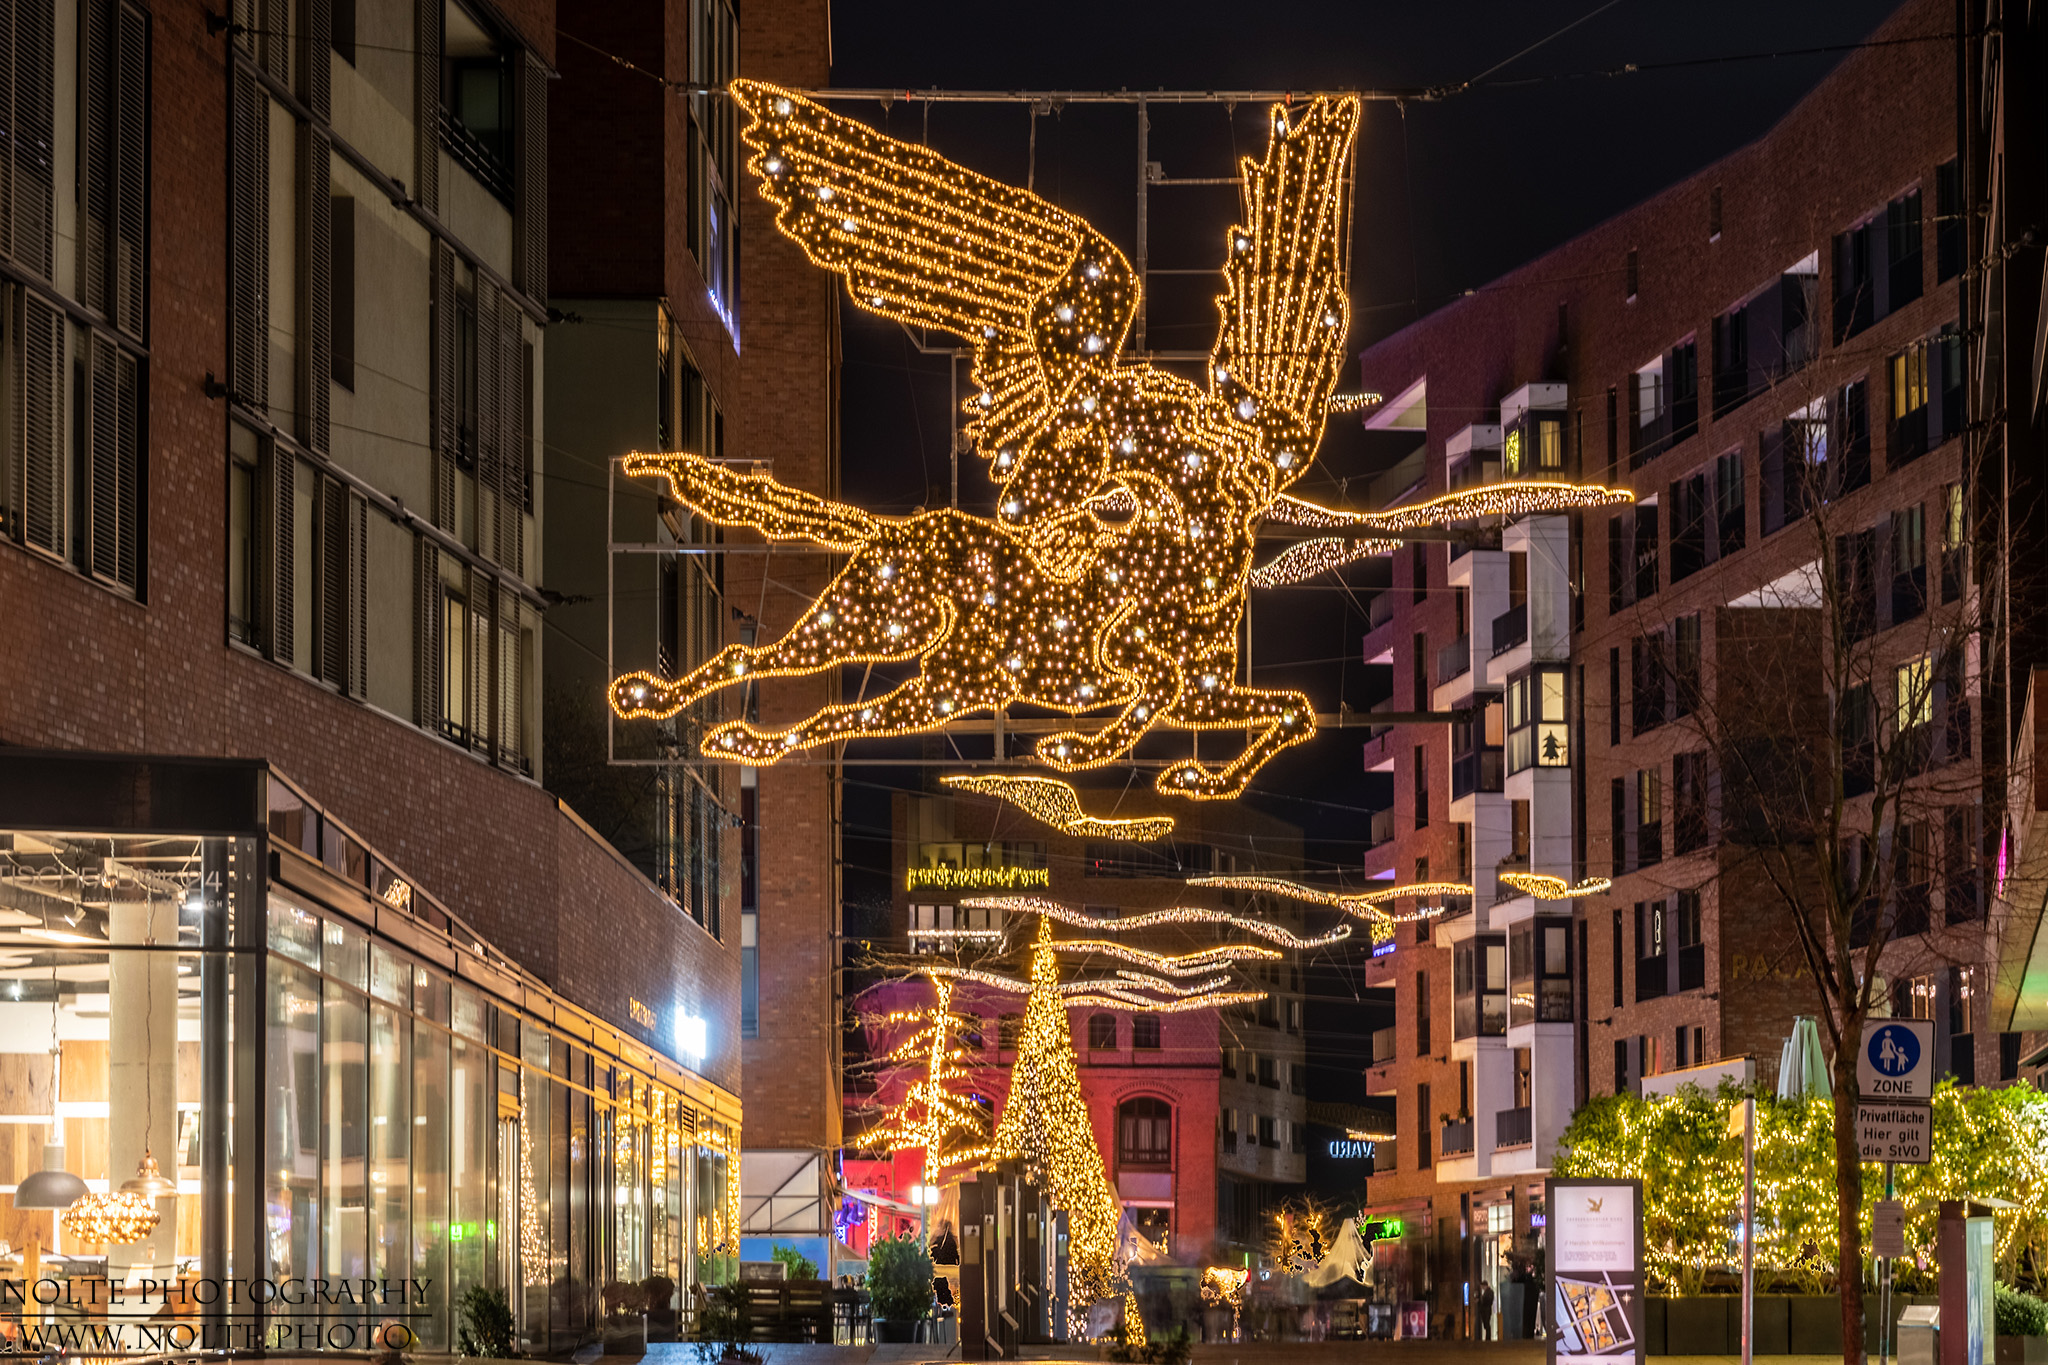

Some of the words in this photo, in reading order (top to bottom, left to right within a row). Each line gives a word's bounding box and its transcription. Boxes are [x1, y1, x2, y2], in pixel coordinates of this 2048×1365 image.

[1872, 1079, 1913, 1094] ZONE
[1860, 1109, 1925, 1124] Privatfläche
[1864, 1127, 1892, 1140] Hier
[1898, 1128, 1920, 1143] gilt
[1862, 1144, 1882, 1157] die
[1888, 1145, 1920, 1158] StVO
